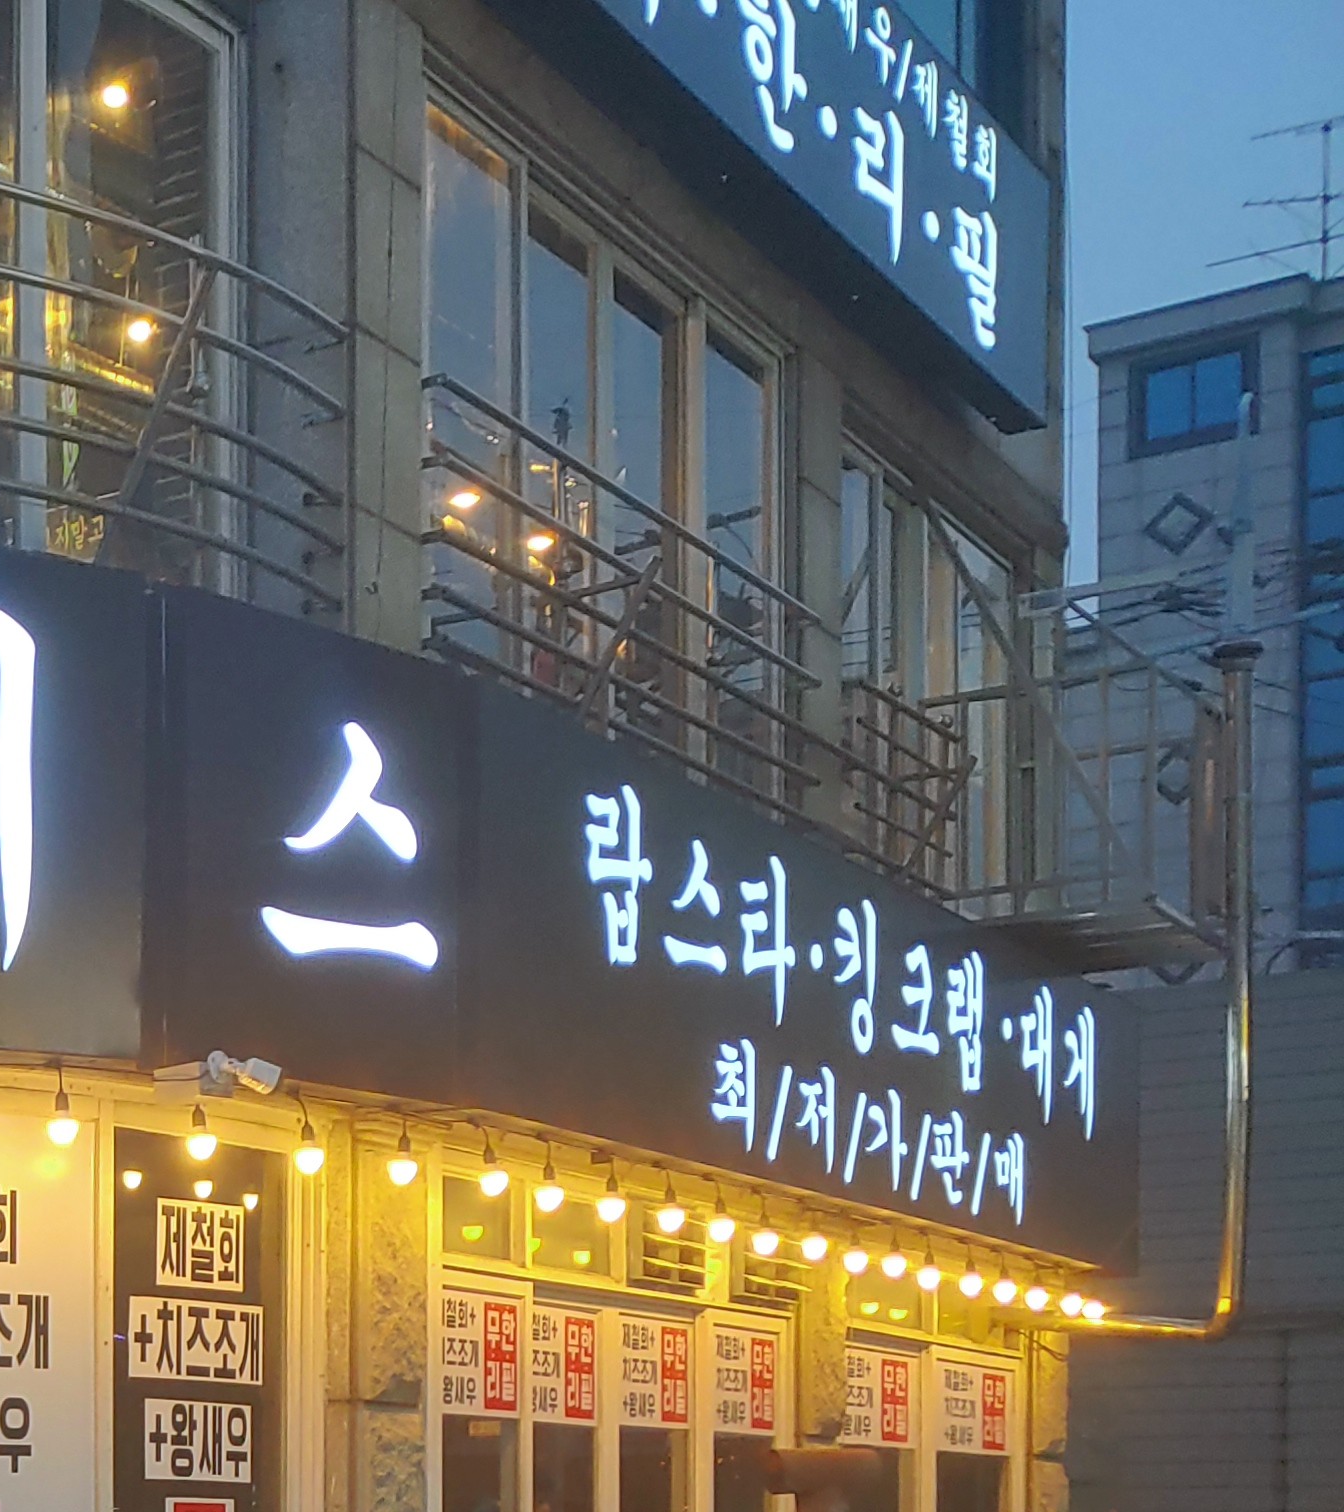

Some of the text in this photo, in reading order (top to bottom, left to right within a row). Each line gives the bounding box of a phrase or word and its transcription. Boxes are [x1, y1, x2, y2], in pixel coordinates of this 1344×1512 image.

[643, 0, 998, 351] ·한·리·필
[45, 512, 105, 552] 지말고
[712, 1037, 1028, 1226] 최/저/가/판/매
[160, 1204, 243, 1285] 제철회
[133, 1299, 261, 1383] +치즈조개
[486, 1310, 516, 1352] 무한
[567, 1323, 593, 1364] 무한
[663, 1333, 686, 1371] 무한
[486, 1360, 516, 1402] 리필
[149, 1401, 250, 1480] +왕새우
